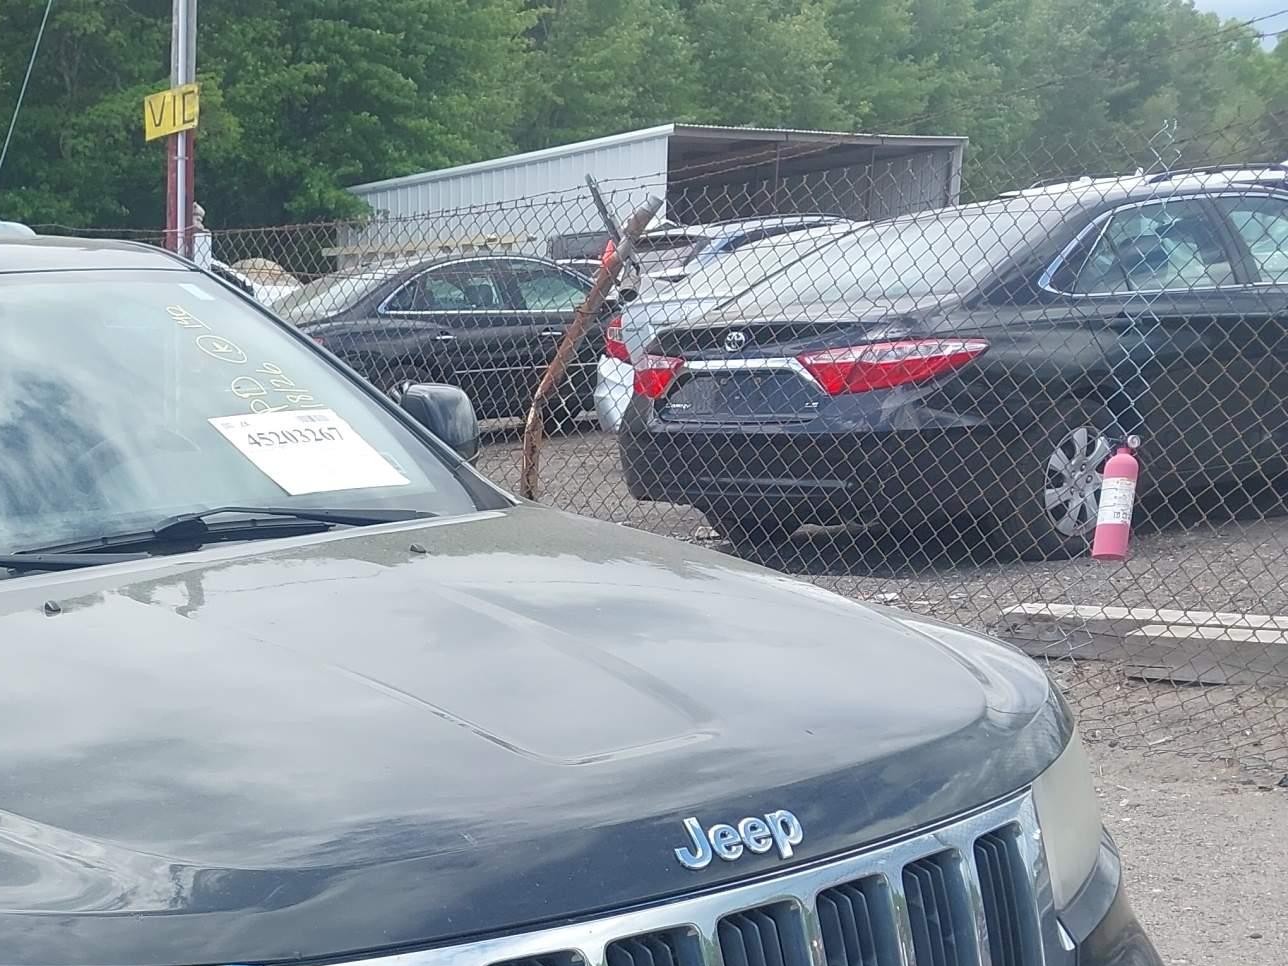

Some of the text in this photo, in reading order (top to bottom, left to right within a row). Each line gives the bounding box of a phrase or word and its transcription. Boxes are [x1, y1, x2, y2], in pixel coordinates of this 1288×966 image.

[148, 90, 195, 127] VIC
[247, 427, 344, 448] 45203267
[674, 809, 804, 870] Jeep
